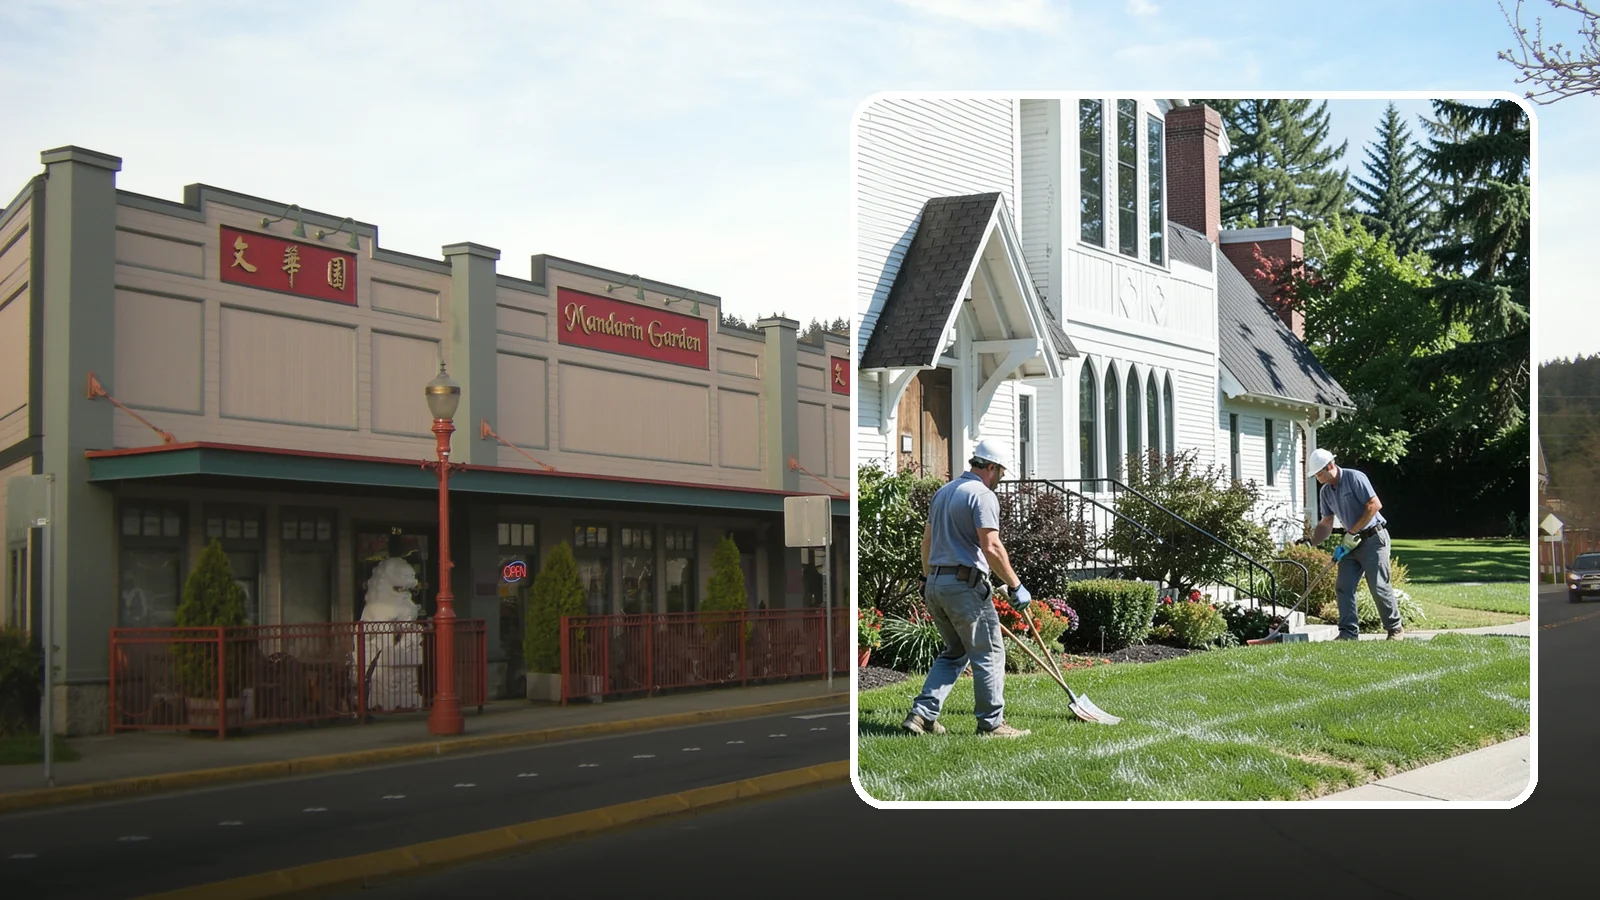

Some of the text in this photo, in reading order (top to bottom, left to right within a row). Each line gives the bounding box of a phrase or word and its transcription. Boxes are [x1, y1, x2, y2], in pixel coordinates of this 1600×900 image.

[230, 235, 346, 290] 文華園
[564, 302, 701, 352] Mandarin Garden
[834, 362, 847, 387] 文
[503, 565, 527, 578] OPEN
